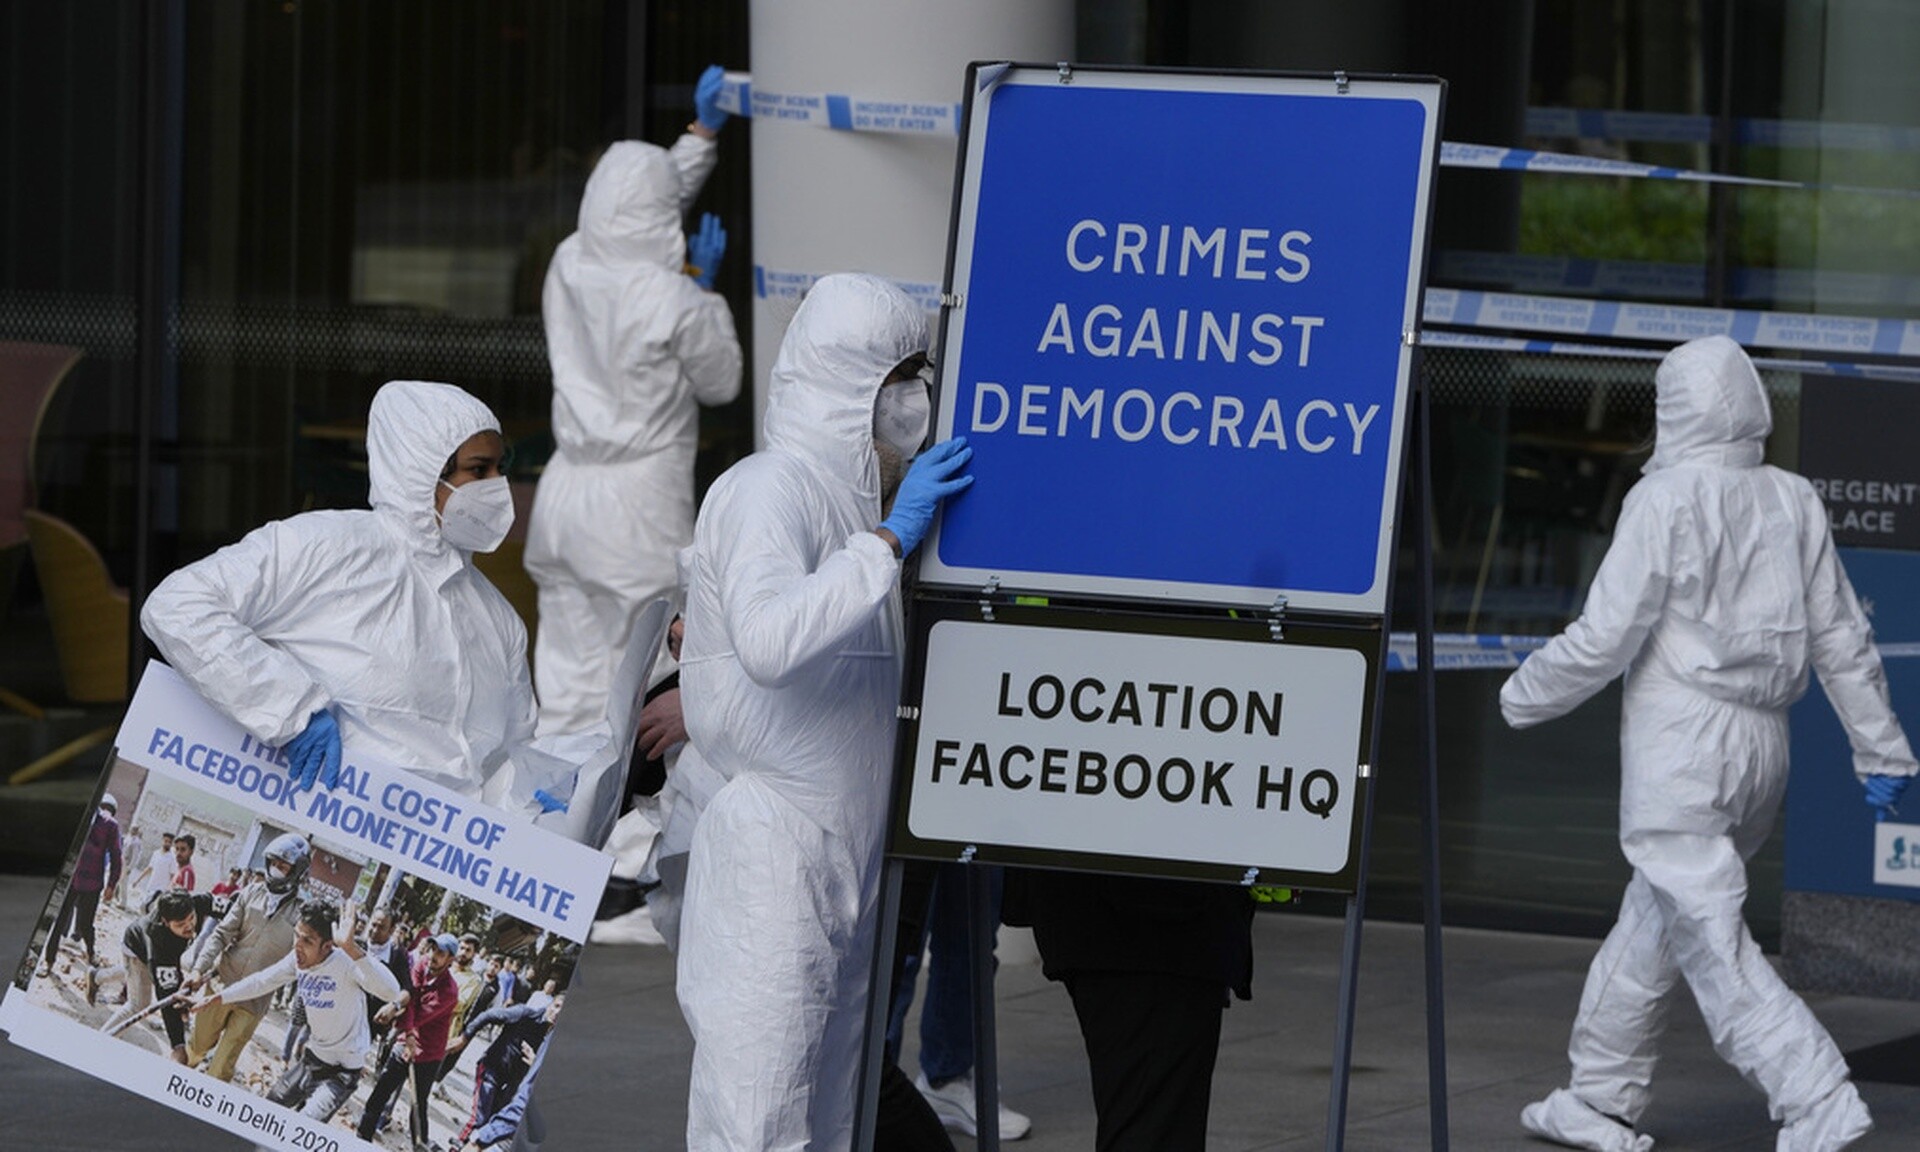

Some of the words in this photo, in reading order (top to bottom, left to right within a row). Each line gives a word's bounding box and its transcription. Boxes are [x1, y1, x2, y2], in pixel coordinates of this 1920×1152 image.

[786, 95, 820, 108] SCENE
[855, 102, 908, 115] INCIDENT
[912, 104, 948, 117] SCENE
[855, 115, 869, 126] DO
[874, 116, 896, 128] NOT
[900, 118, 936, 130] ENTER
[1065, 219, 1313, 283] CRIMES
[1037, 303, 1325, 368] AGAINST
[971, 382, 1381, 456] DEMOCRACY
[1827, 508, 1895, 533] LACE
[998, 672, 1284, 737] LOCATION
[931, 740, 1235, 807] FACEBOOK
[1256, 765, 1339, 820] HQ
[148, 727, 303, 811] FACEBOOK
[307, 791, 493, 888] MONETIZING
[494, 866, 576, 922] HATE
[380, 782, 462, 835] COST
[464, 816, 506, 851] OF
[166, 1074, 215, 1110] Riots
[217, 1094, 235, 1118] in
[238, 1104, 287, 1142] Delhi,
[291, 1127, 339, 1152] 2020
